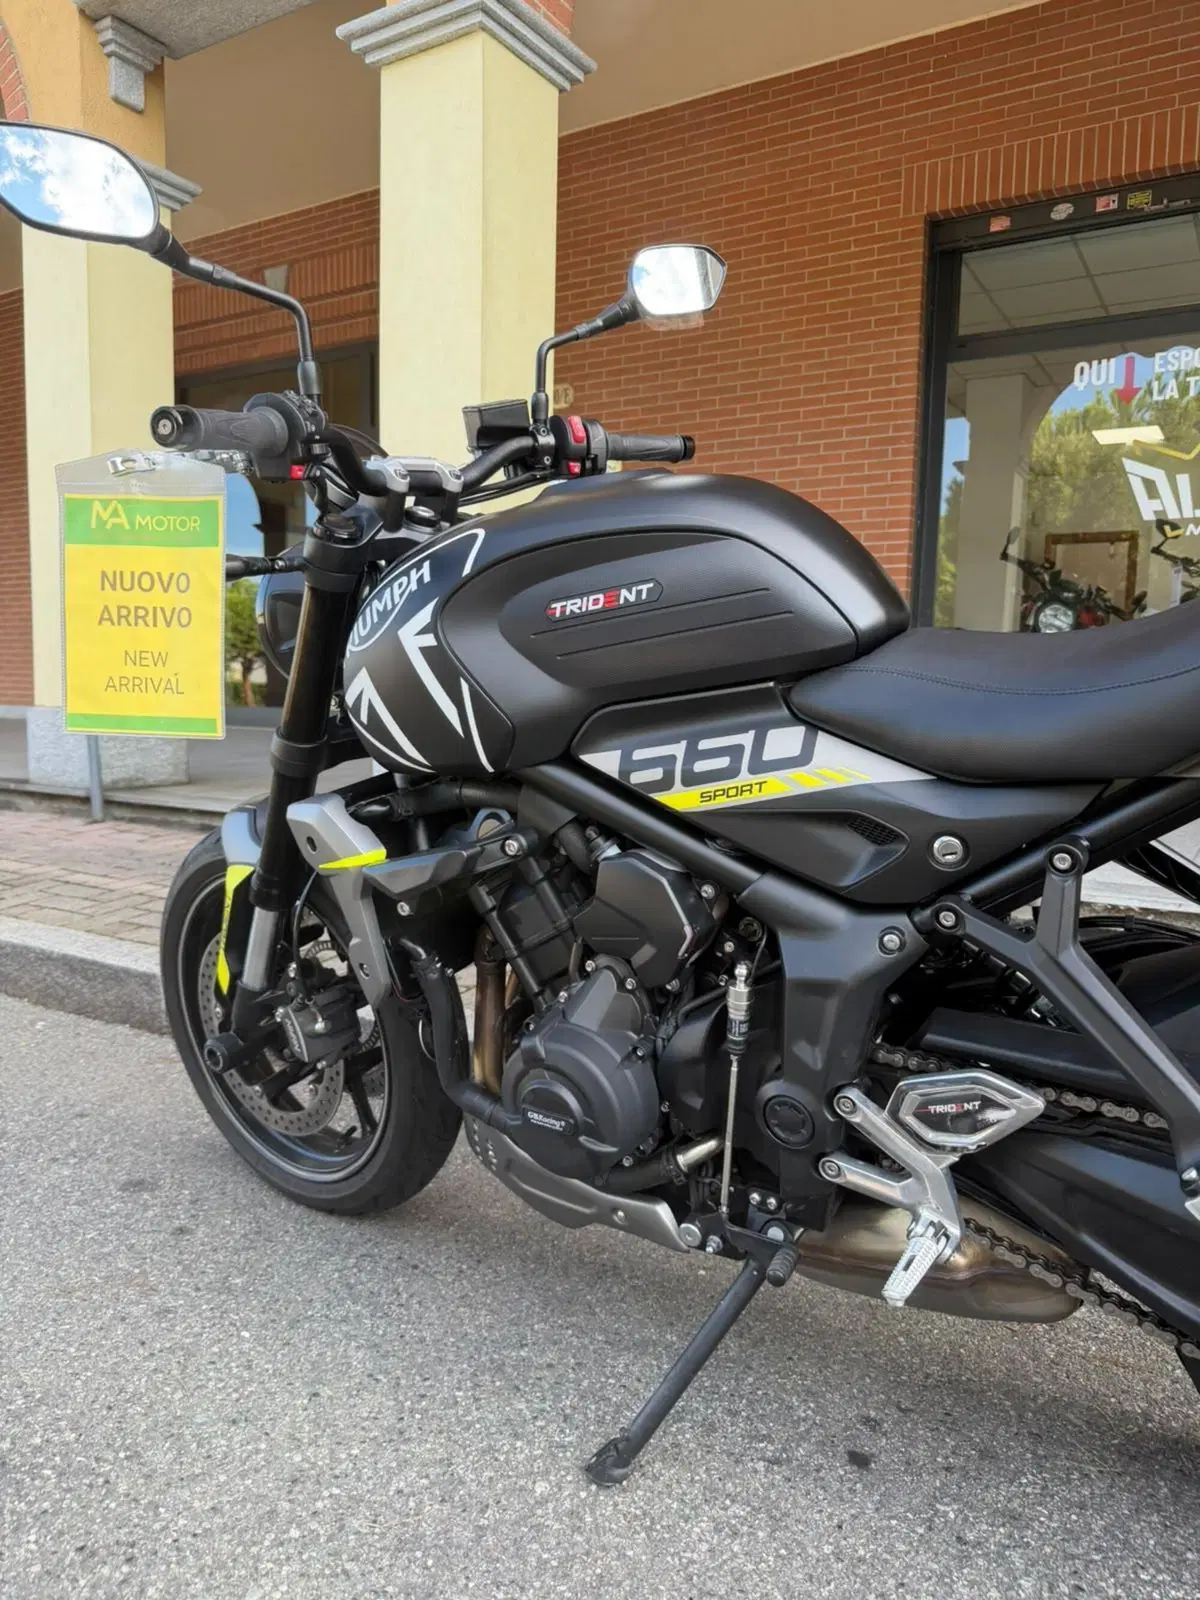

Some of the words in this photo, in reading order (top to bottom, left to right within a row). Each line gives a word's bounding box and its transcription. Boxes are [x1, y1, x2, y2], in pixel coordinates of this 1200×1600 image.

[1073, 358, 1115, 391] QUI
[1153, 379, 1179, 400] LA
[91, 500, 130, 529] MA
[136, 515, 200, 532] MOTOR
[100, 570, 190, 593] NUOVO
[349, 560, 430, 650] IUMPH
[551, 583, 654, 617] TRIDENT
[98, 605, 192, 628] ARRIVO
[124, 650, 168, 667] NEW
[105, 675, 184, 694] ARRIVAL
[618, 724, 818, 794] 660
[700, 781, 767, 803] SPORT
[929, 1101, 981, 1115] TRIDENT
